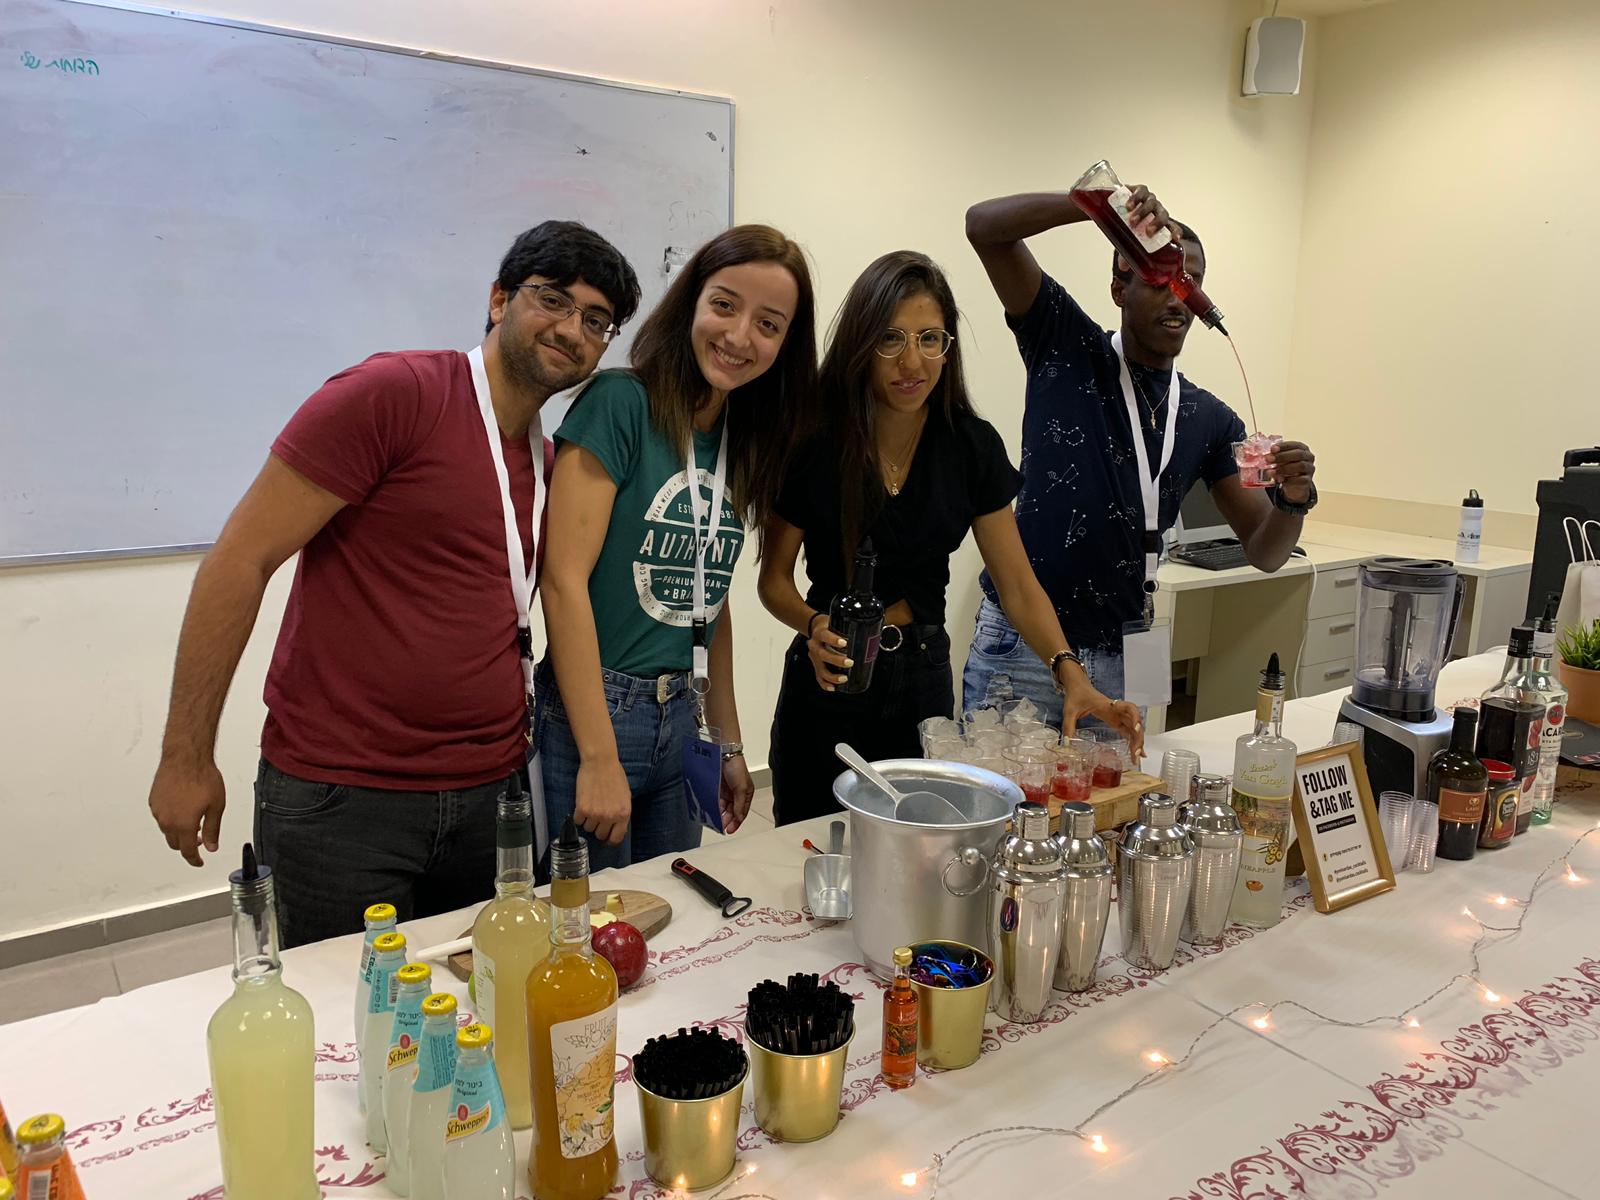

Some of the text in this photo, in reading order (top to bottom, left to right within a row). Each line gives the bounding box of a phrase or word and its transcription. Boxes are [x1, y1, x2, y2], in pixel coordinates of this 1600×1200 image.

[1302, 765, 1348, 795] FOLLOW
[1310, 790, 1355, 819] &TAG ME
